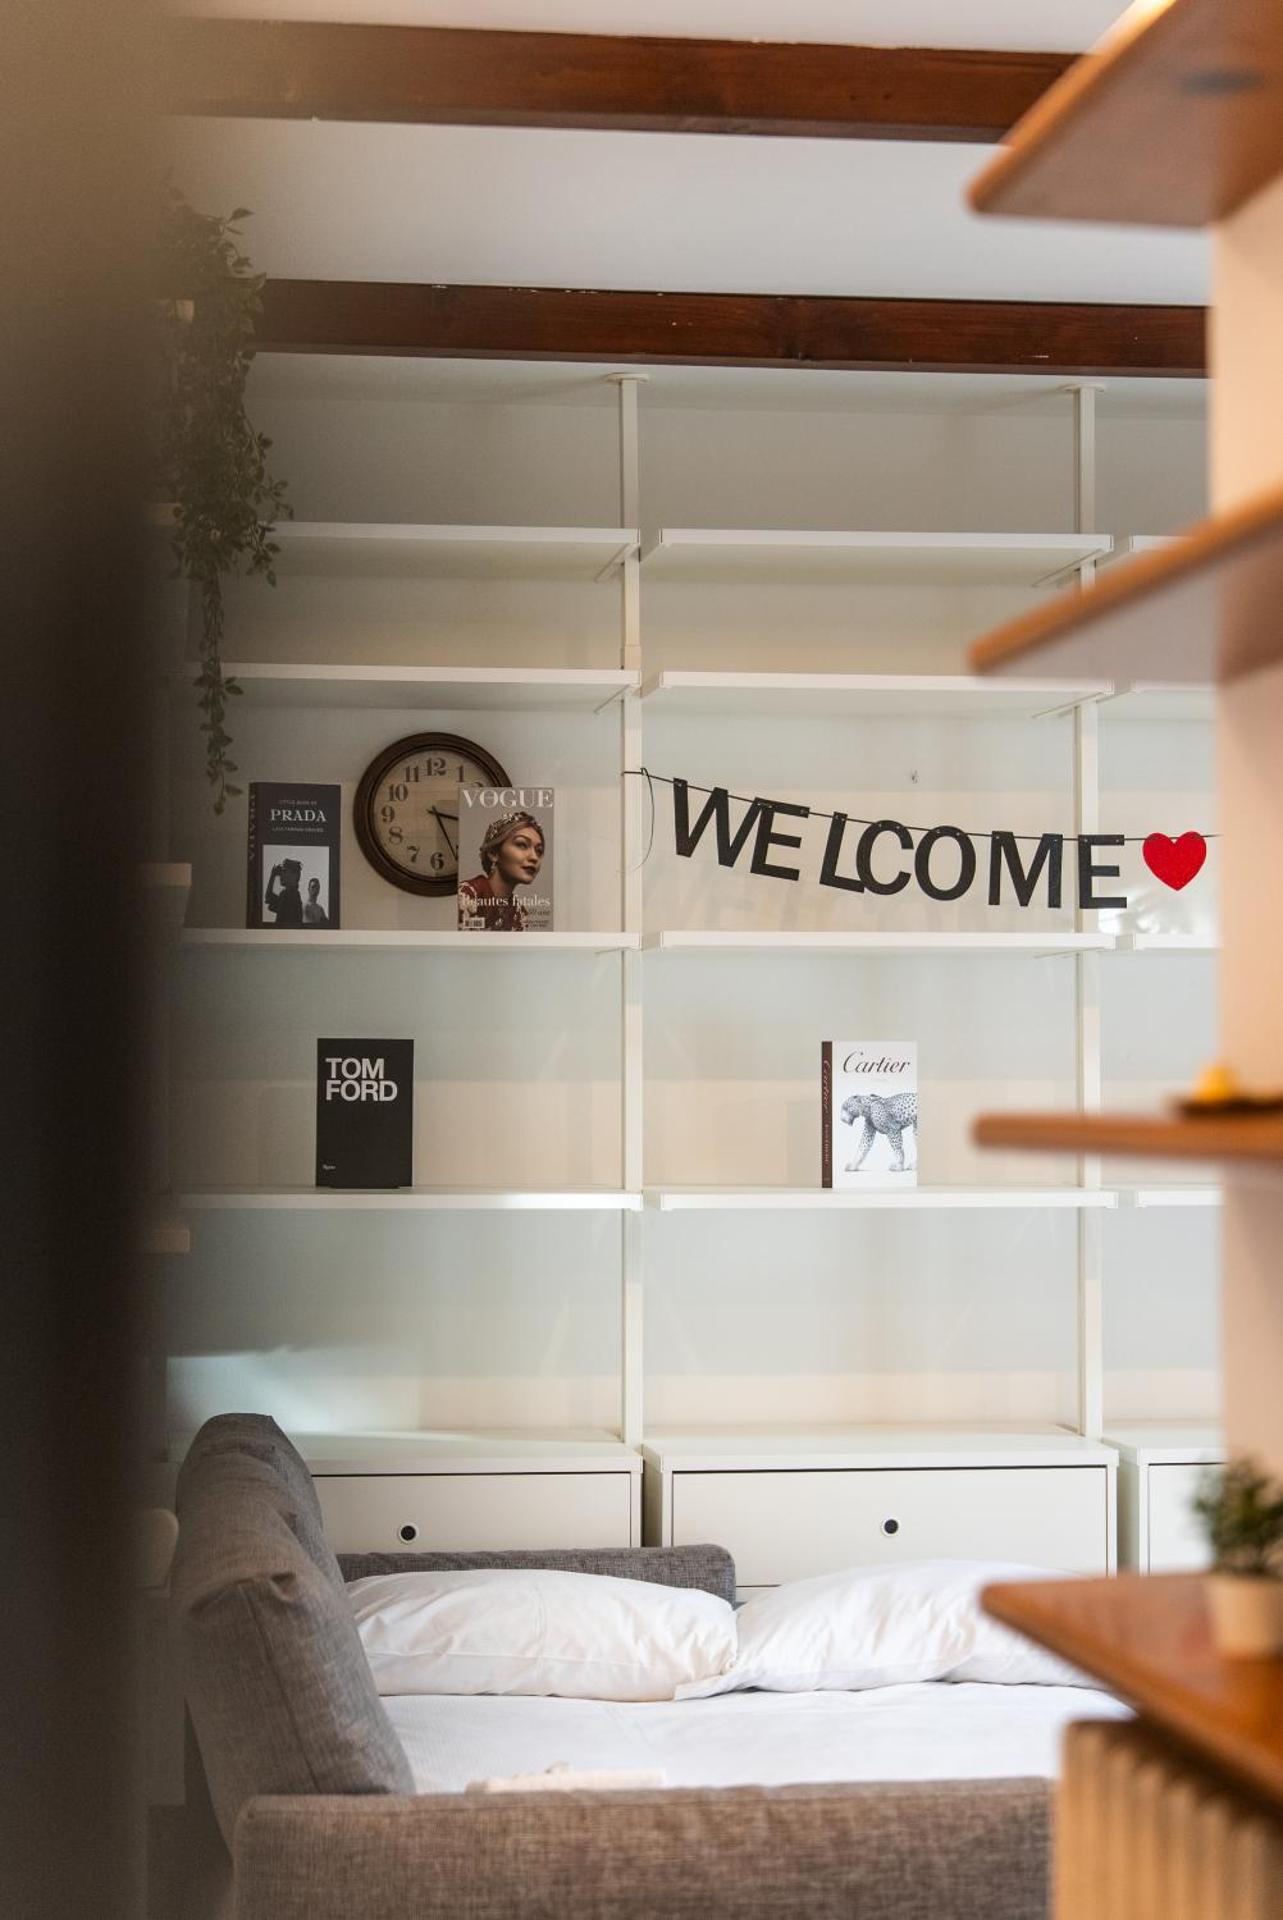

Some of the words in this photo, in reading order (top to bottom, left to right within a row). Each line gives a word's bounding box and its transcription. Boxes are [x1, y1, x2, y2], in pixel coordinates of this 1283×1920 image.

[404, 766, 419, 783] 11
[425, 757, 447, 776] 12
[456, 765, 465, 783] 1
[387, 783, 408, 801] 10
[462, 789, 553, 809] VOGUE
[270, 808, 327, 822] PRADA
[381, 805, 395, 823] 9
[388, 826, 403, 845] 8
[673, 777, 1127, 909] WELCOME
[406, 845, 419, 863] 7
[430, 852, 444, 871] 6
[325, 1057, 385, 1080] TOM
[843, 1050, 911, 1074] Cartier
[326, 1079, 398, 1102] FORD
